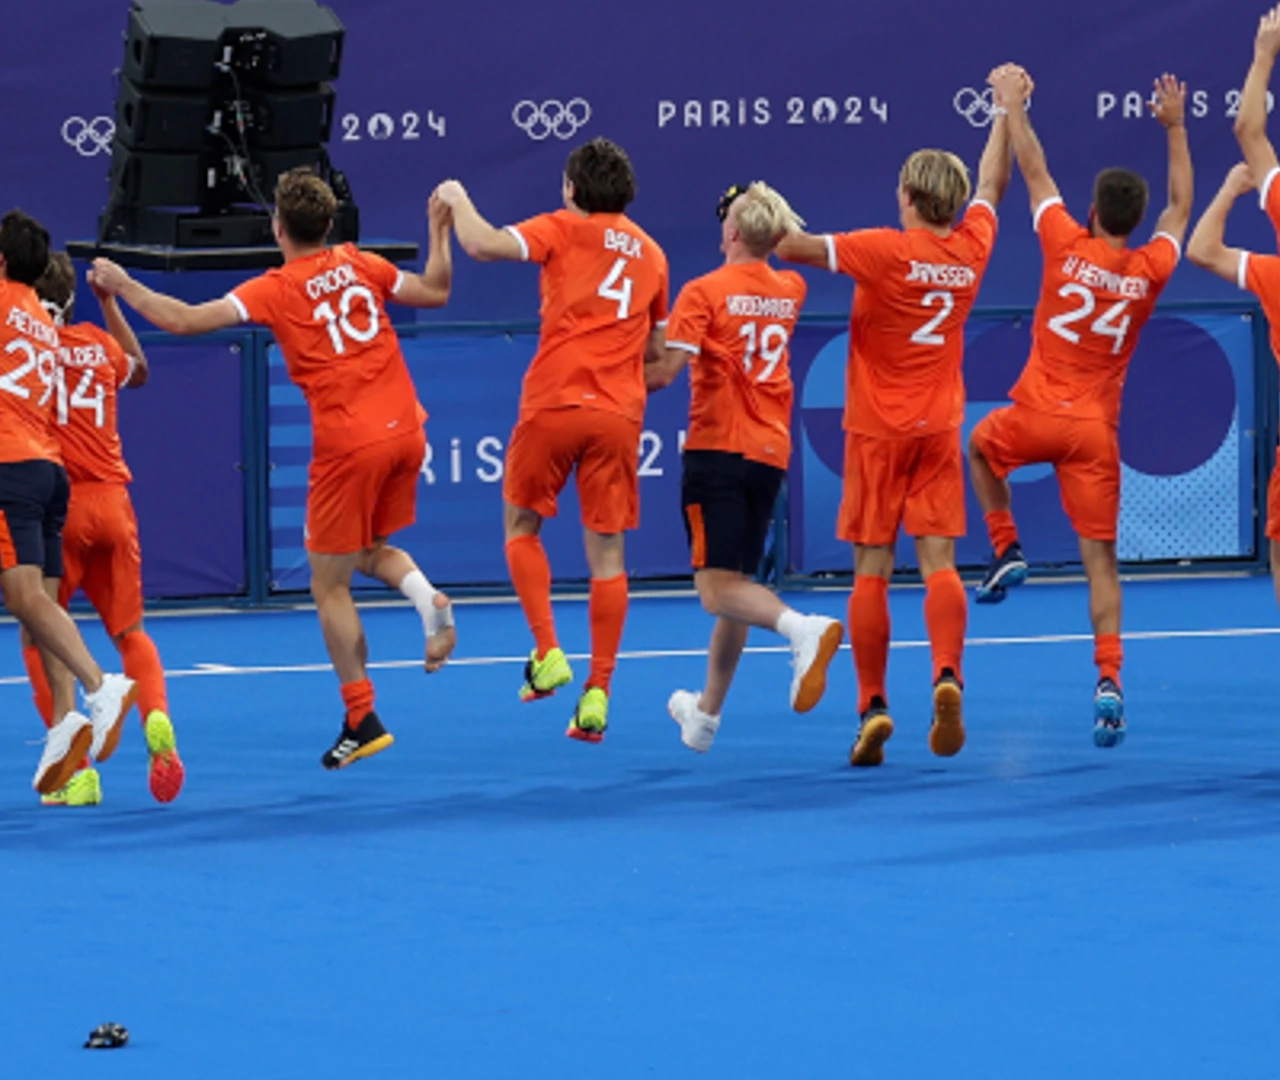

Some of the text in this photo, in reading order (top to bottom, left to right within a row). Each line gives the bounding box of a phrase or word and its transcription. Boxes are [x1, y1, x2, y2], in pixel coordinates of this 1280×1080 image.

[341, 110, 446, 141] 2024
[658, 95, 888, 128] PARIS 2024
[1096, 90, 1209, 119] PAS
[597, 257, 634, 320] 4
[909, 289, 955, 346] 2
[1046, 282, 1132, 356] 24
[313, 285, 381, 355] 10
[738, 321, 789, 383] 19
[56, 366, 106, 429] 14
